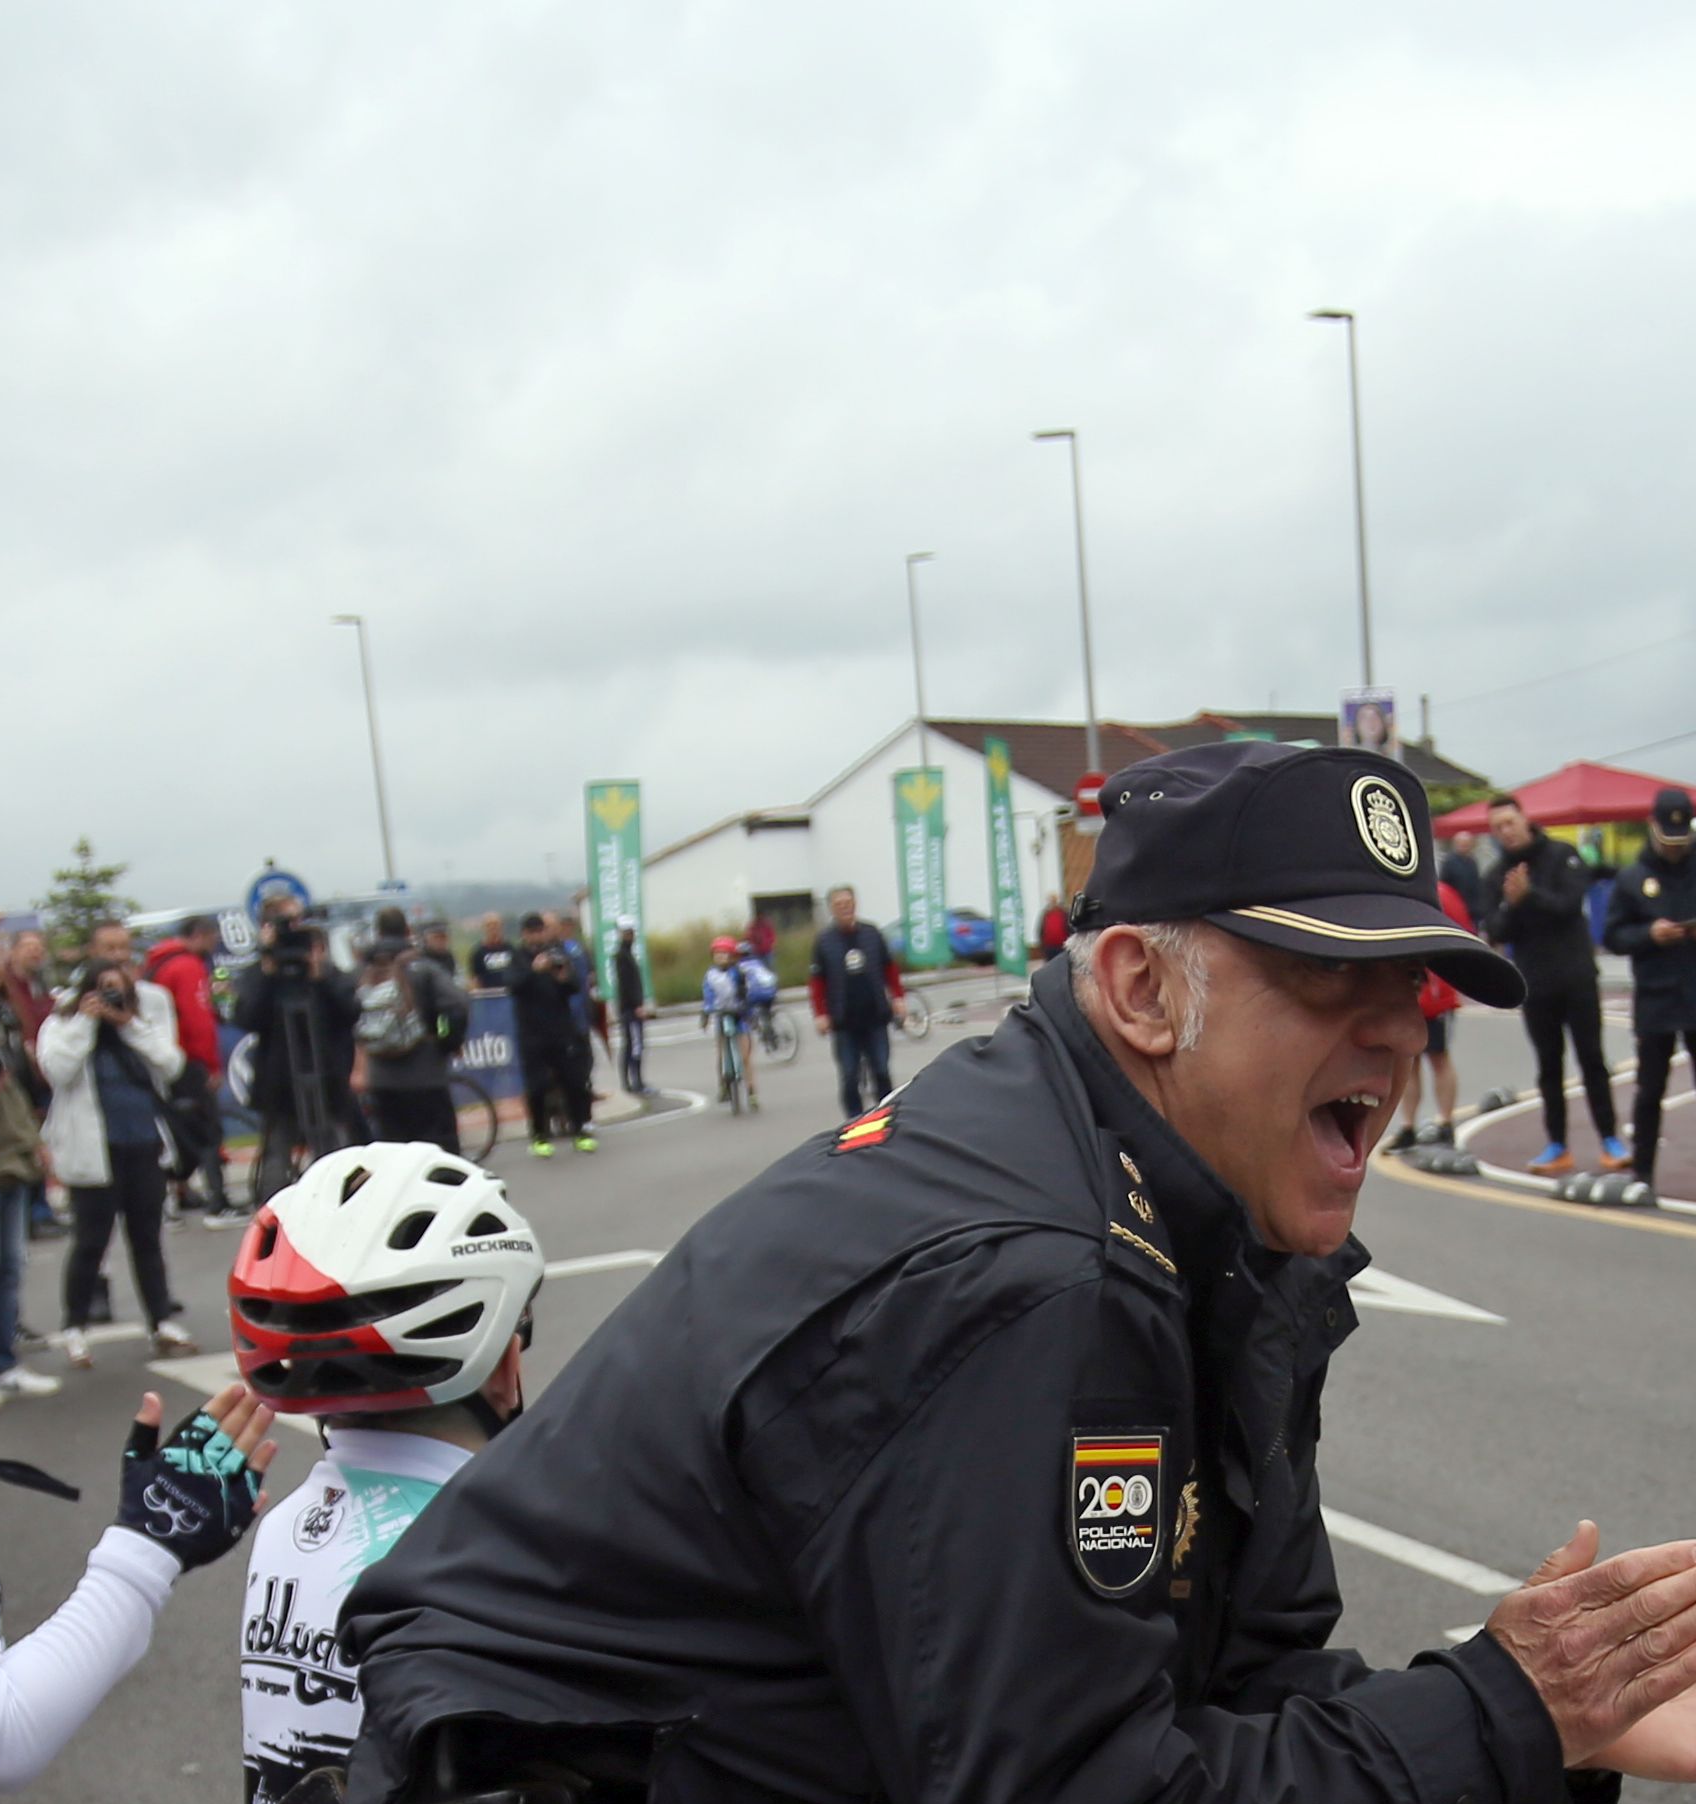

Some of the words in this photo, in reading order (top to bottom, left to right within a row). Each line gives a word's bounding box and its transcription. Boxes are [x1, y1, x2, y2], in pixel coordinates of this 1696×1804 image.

[909, 898, 930, 954] CAJA
[451, 1240, 534, 1258] ROCKRIDER
[1079, 1474, 1153, 1519] 200
[1078, 1525, 1137, 1539] POLICIA
[1079, 1536, 1153, 1551] NACIONAL
